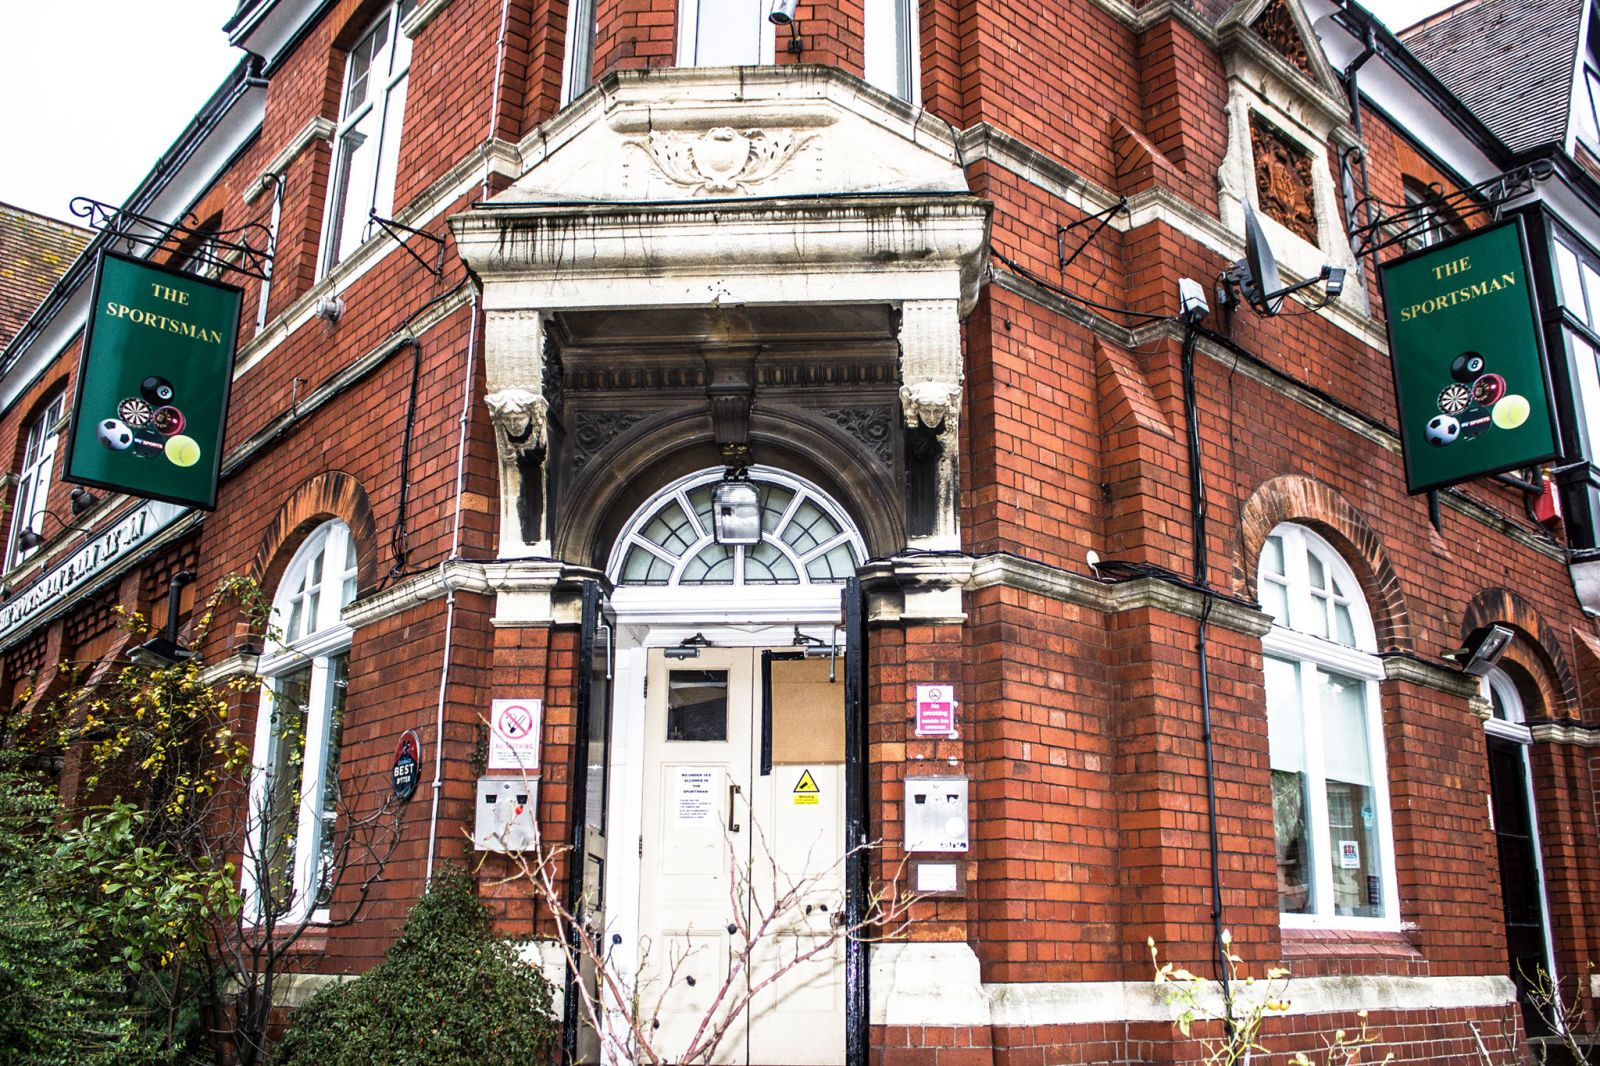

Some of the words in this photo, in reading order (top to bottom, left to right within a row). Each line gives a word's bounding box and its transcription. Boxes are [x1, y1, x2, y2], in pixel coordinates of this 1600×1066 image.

[1432, 256, 1472, 280] THE
[151, 283, 190, 306] THE
[1400, 271, 1516, 322] SPORTSMAN
[106, 301, 223, 345] SPORTSMAN
[1471, 360, 1479, 369] 8
[160, 388, 169, 397] 8
[1469, 416, 1491, 426] SPORTS
[142, 440, 163, 449] SPORTS
[922, 710, 949, 718] smoking
[393, 763, 414, 777] BEST
